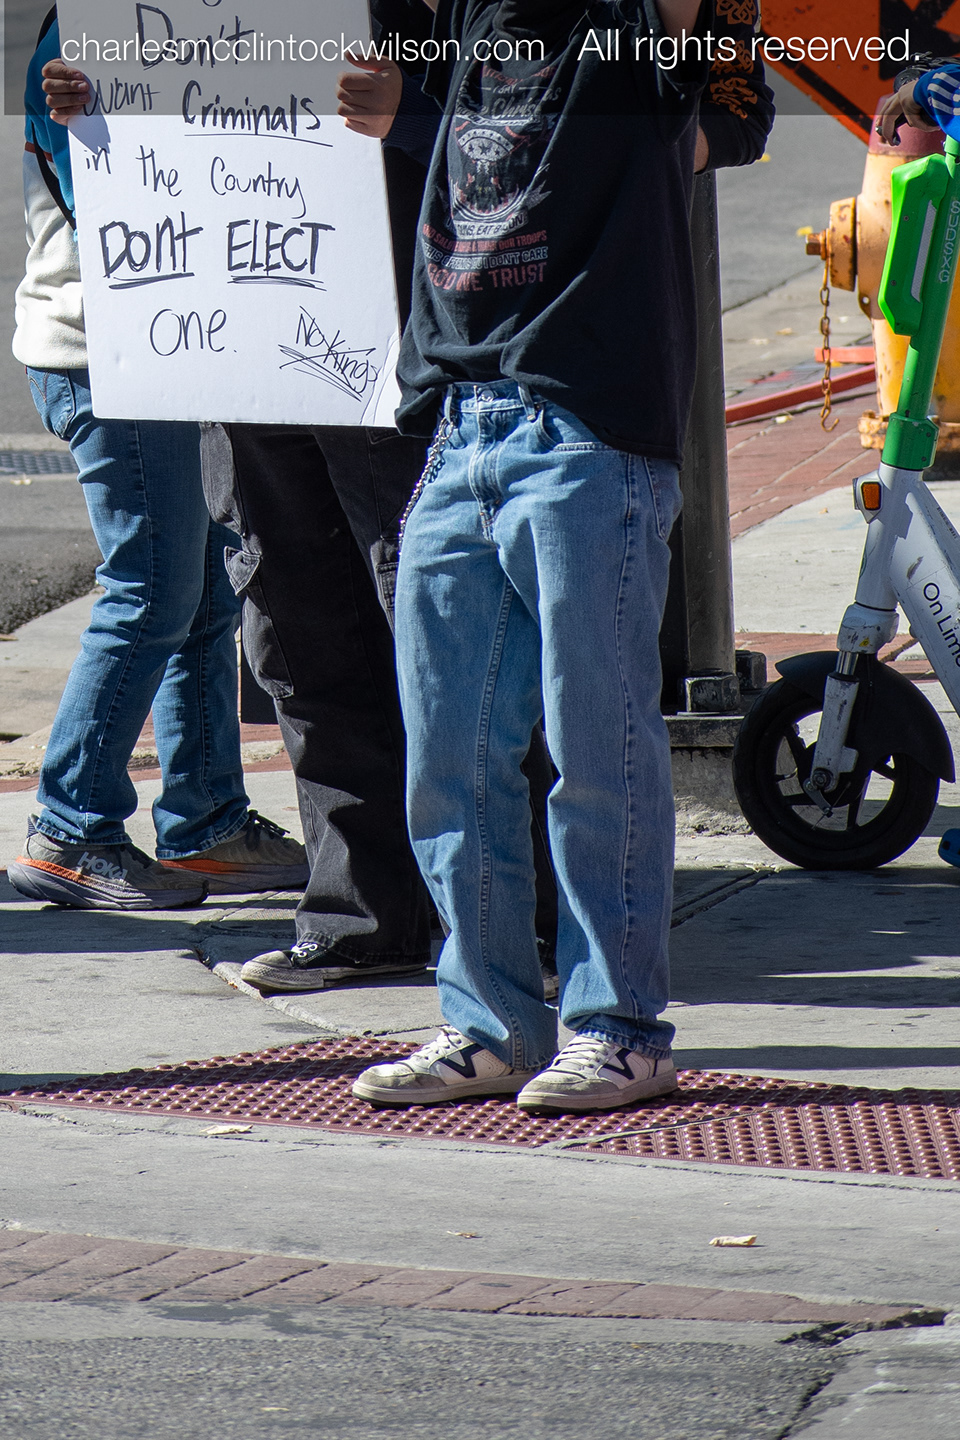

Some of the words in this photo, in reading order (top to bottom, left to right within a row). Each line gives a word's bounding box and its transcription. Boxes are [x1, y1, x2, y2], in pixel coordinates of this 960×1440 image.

[181, 79, 321, 137] Criminals
[83, 147, 112, 175] in
[135, 144, 183, 197] the
[210, 155, 307, 220] Country
[226, 218, 337, 276] ELECT
[516, 230, 548, 247] TROOPS
[521, 246, 549, 263] CARE
[488, 261, 548, 289] TRUST
[295, 312, 327, 348] No
[923, 582, 944, 617] On
[77, 851, 129, 880] HOKA
